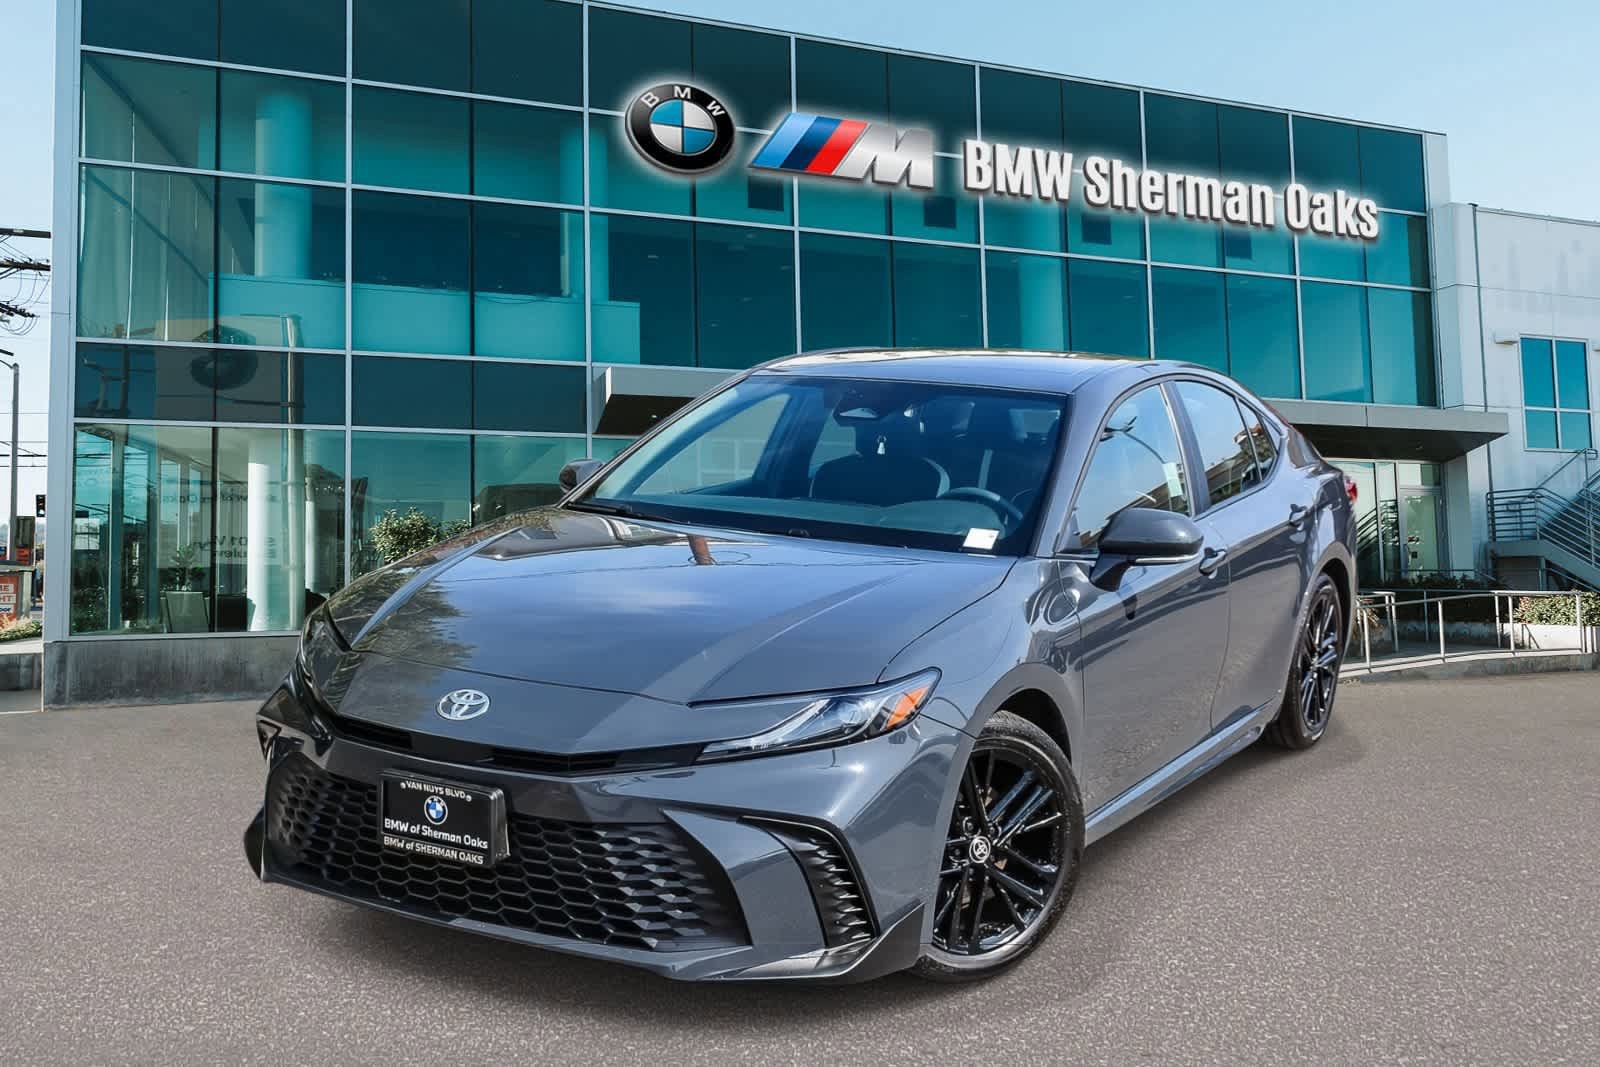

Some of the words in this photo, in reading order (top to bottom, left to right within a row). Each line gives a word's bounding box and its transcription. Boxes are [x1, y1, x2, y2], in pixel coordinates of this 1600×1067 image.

[641, 85, 726, 117] BMW
[964, 139, 1073, 202] BMW
[1083, 155, 1275, 227] Sherman
[1284, 183, 1379, 240] Oaks
[405, 780, 422, 790] VAN
[423, 784, 445, 795] NUYS
[445, 788, 466, 799] BLVD
[384, 818, 409, 832] BMW
[410, 824, 420, 834] of
[421, 826, 461, 844] Sherman
[463, 835, 488, 849] Oaks
[383, 836, 405, 849] BMW
[405, 841, 414, 850] of
[415, 844, 458, 860] SHERMAN
[459, 852, 484, 865] OAKS
